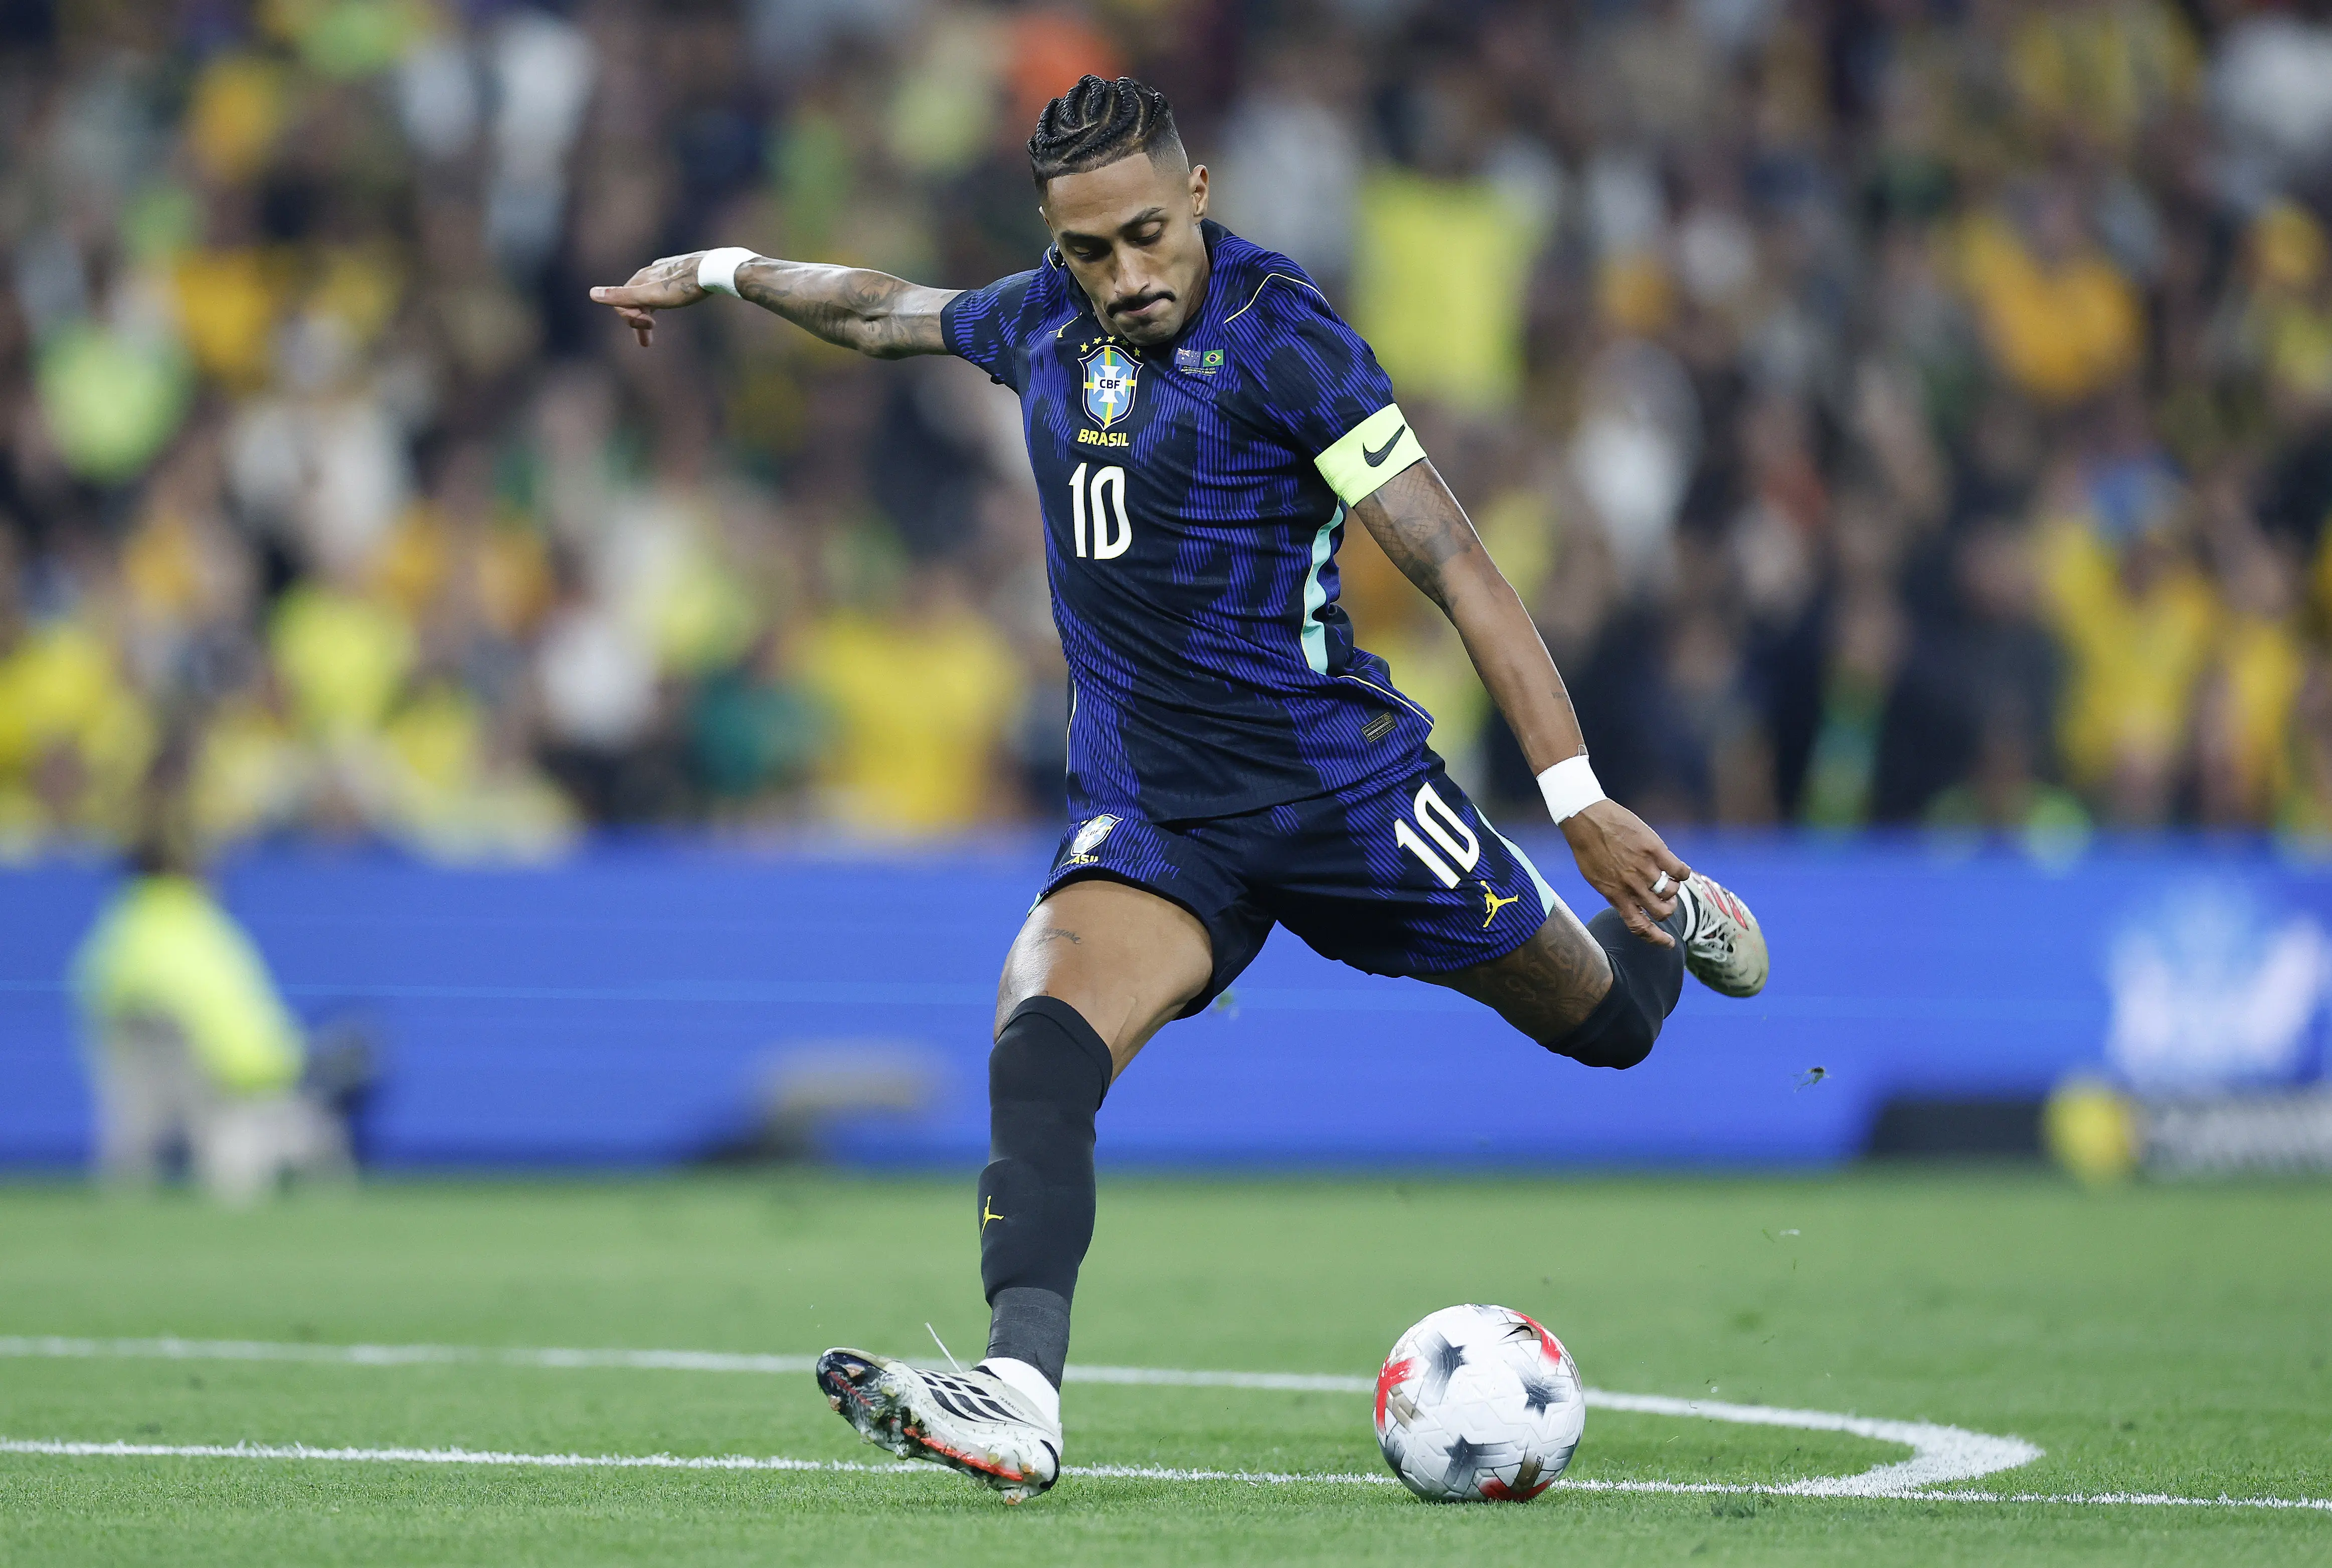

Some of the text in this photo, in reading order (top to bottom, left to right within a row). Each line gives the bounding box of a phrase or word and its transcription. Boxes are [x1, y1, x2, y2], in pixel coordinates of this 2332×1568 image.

[1100, 379, 1121, 389] CBF
[1078, 429, 1130, 447] BRASIL
[1068, 462, 1132, 560] 10
[1086, 829, 1101, 837] CBF
[1394, 781, 1480, 889] 10
